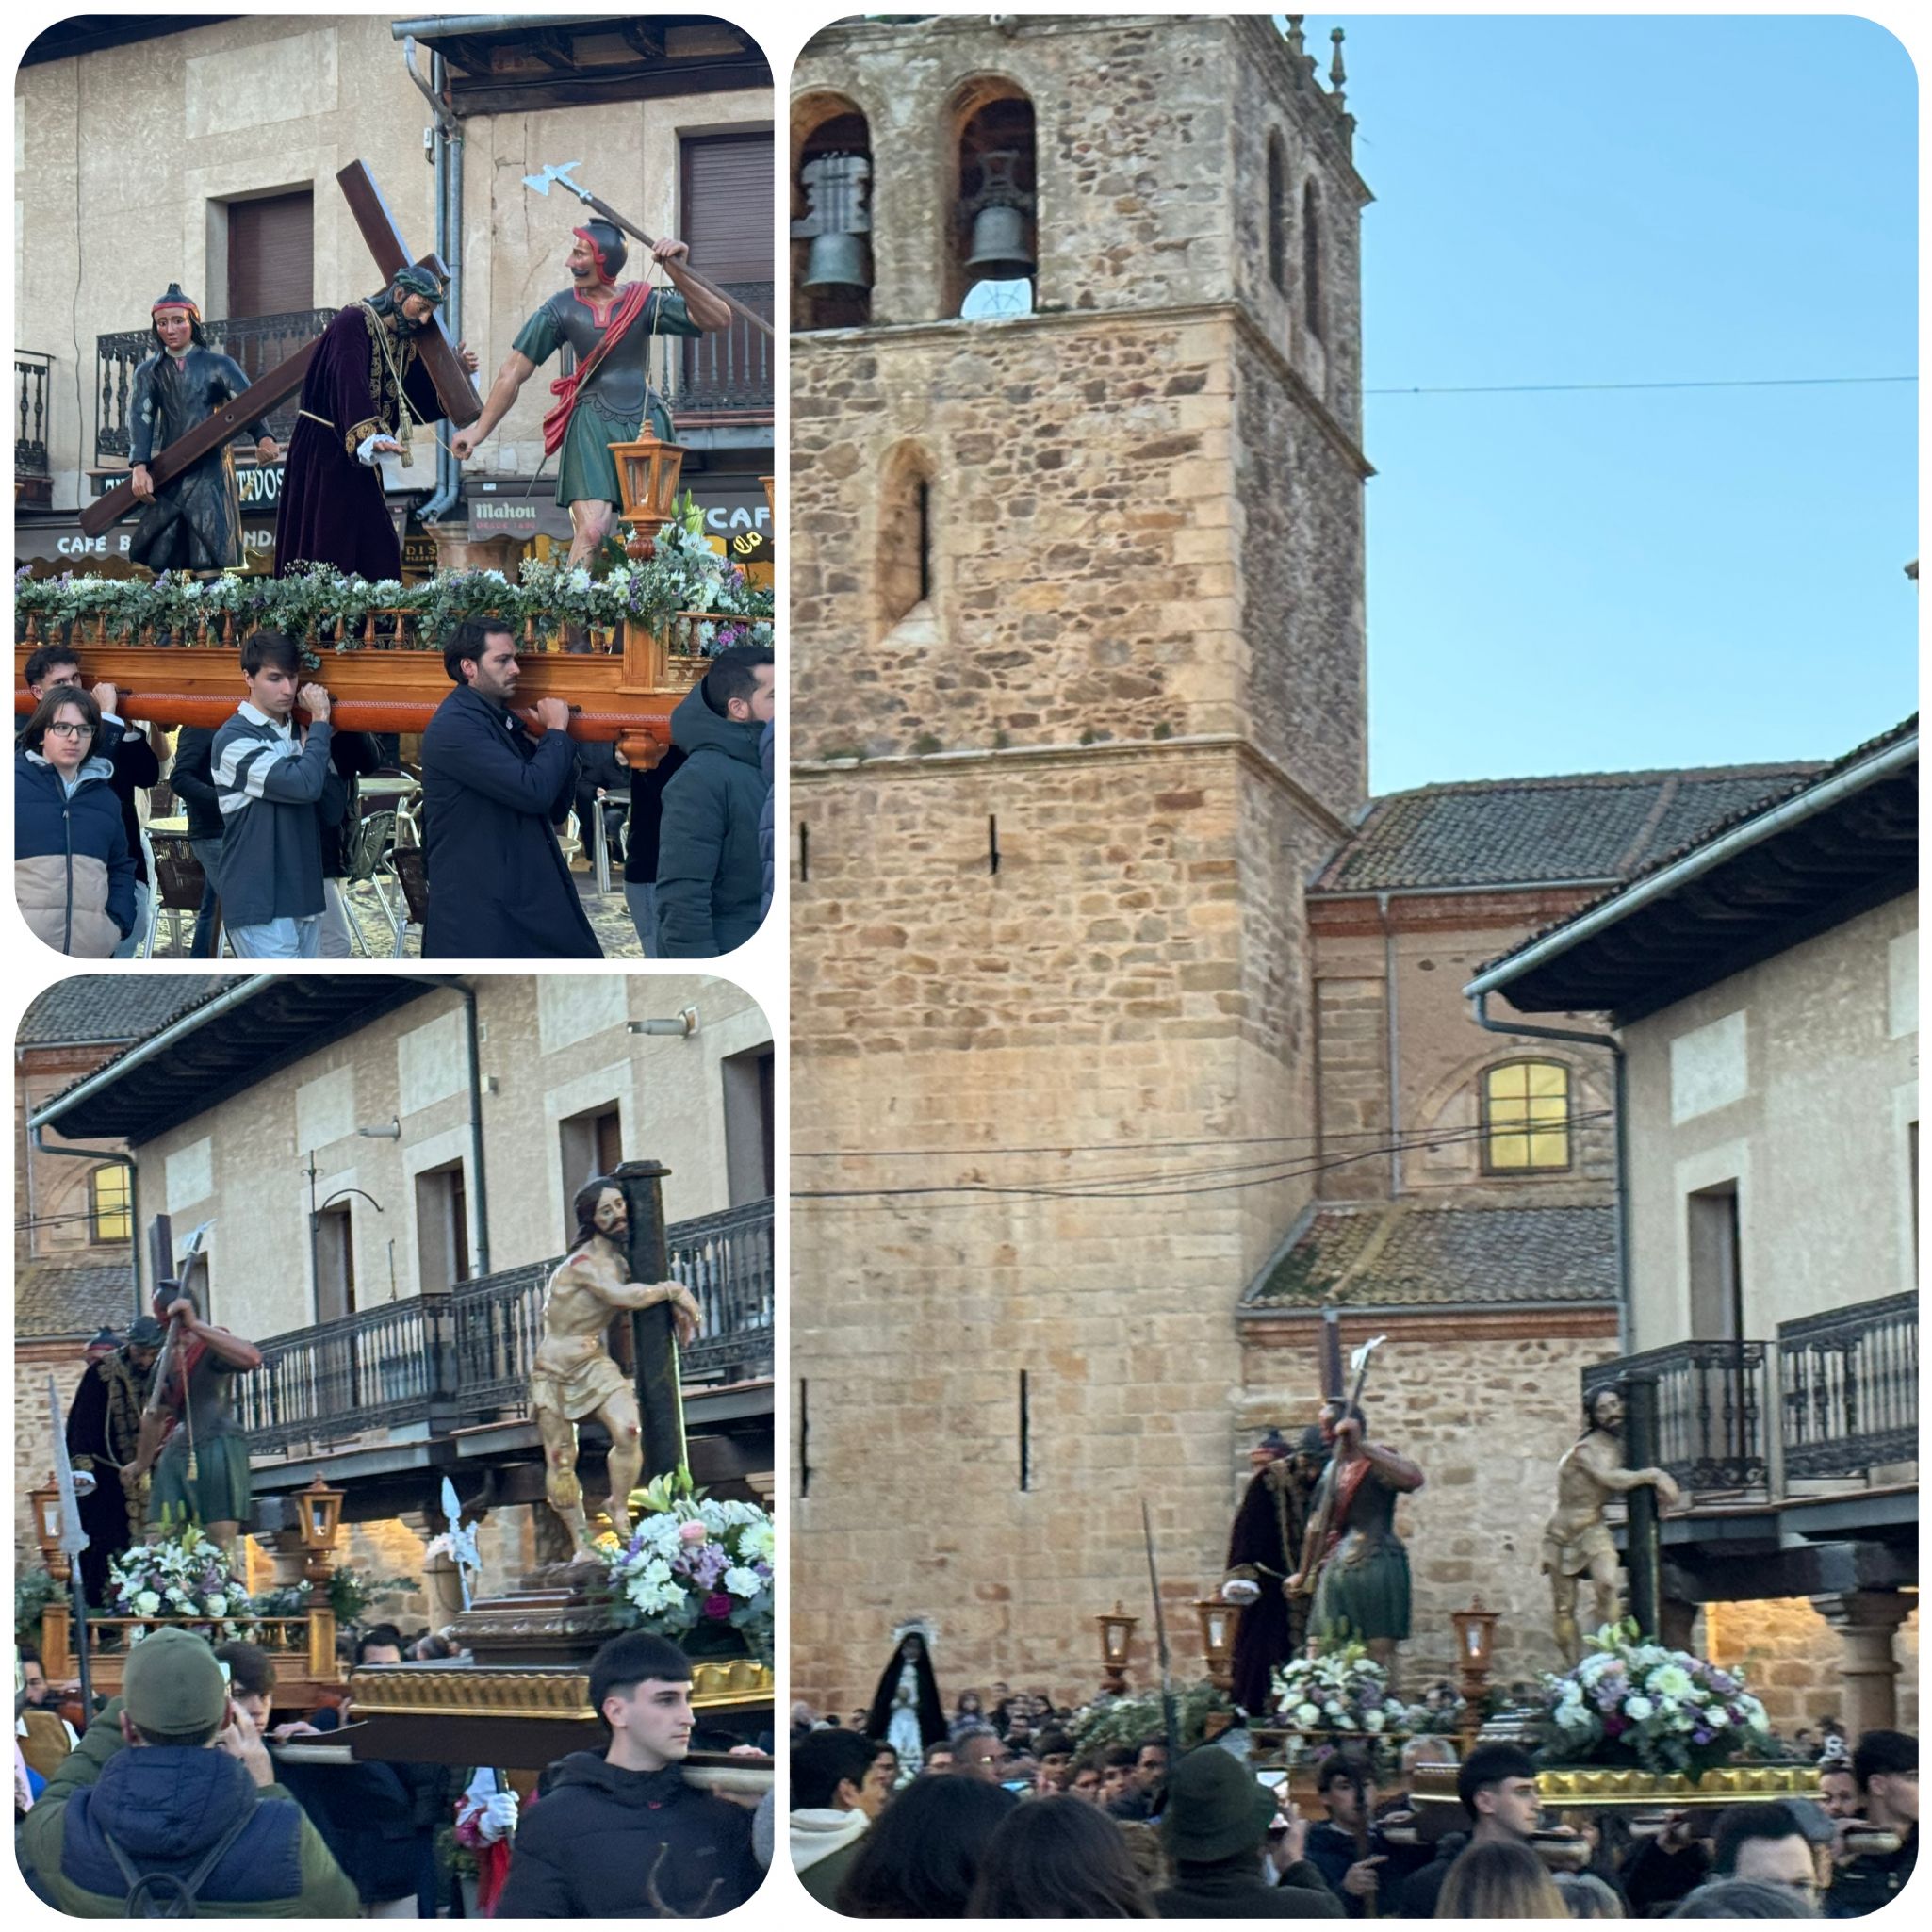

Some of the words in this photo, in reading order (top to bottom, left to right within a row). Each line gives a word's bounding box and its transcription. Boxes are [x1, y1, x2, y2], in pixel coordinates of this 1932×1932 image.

[236, 467, 285, 502] TIVOS
[475, 501, 536, 519] Mahou
[706, 506, 771, 529] CAF
[119, 534, 132, 551] B
[405, 545, 436, 555] DIS
